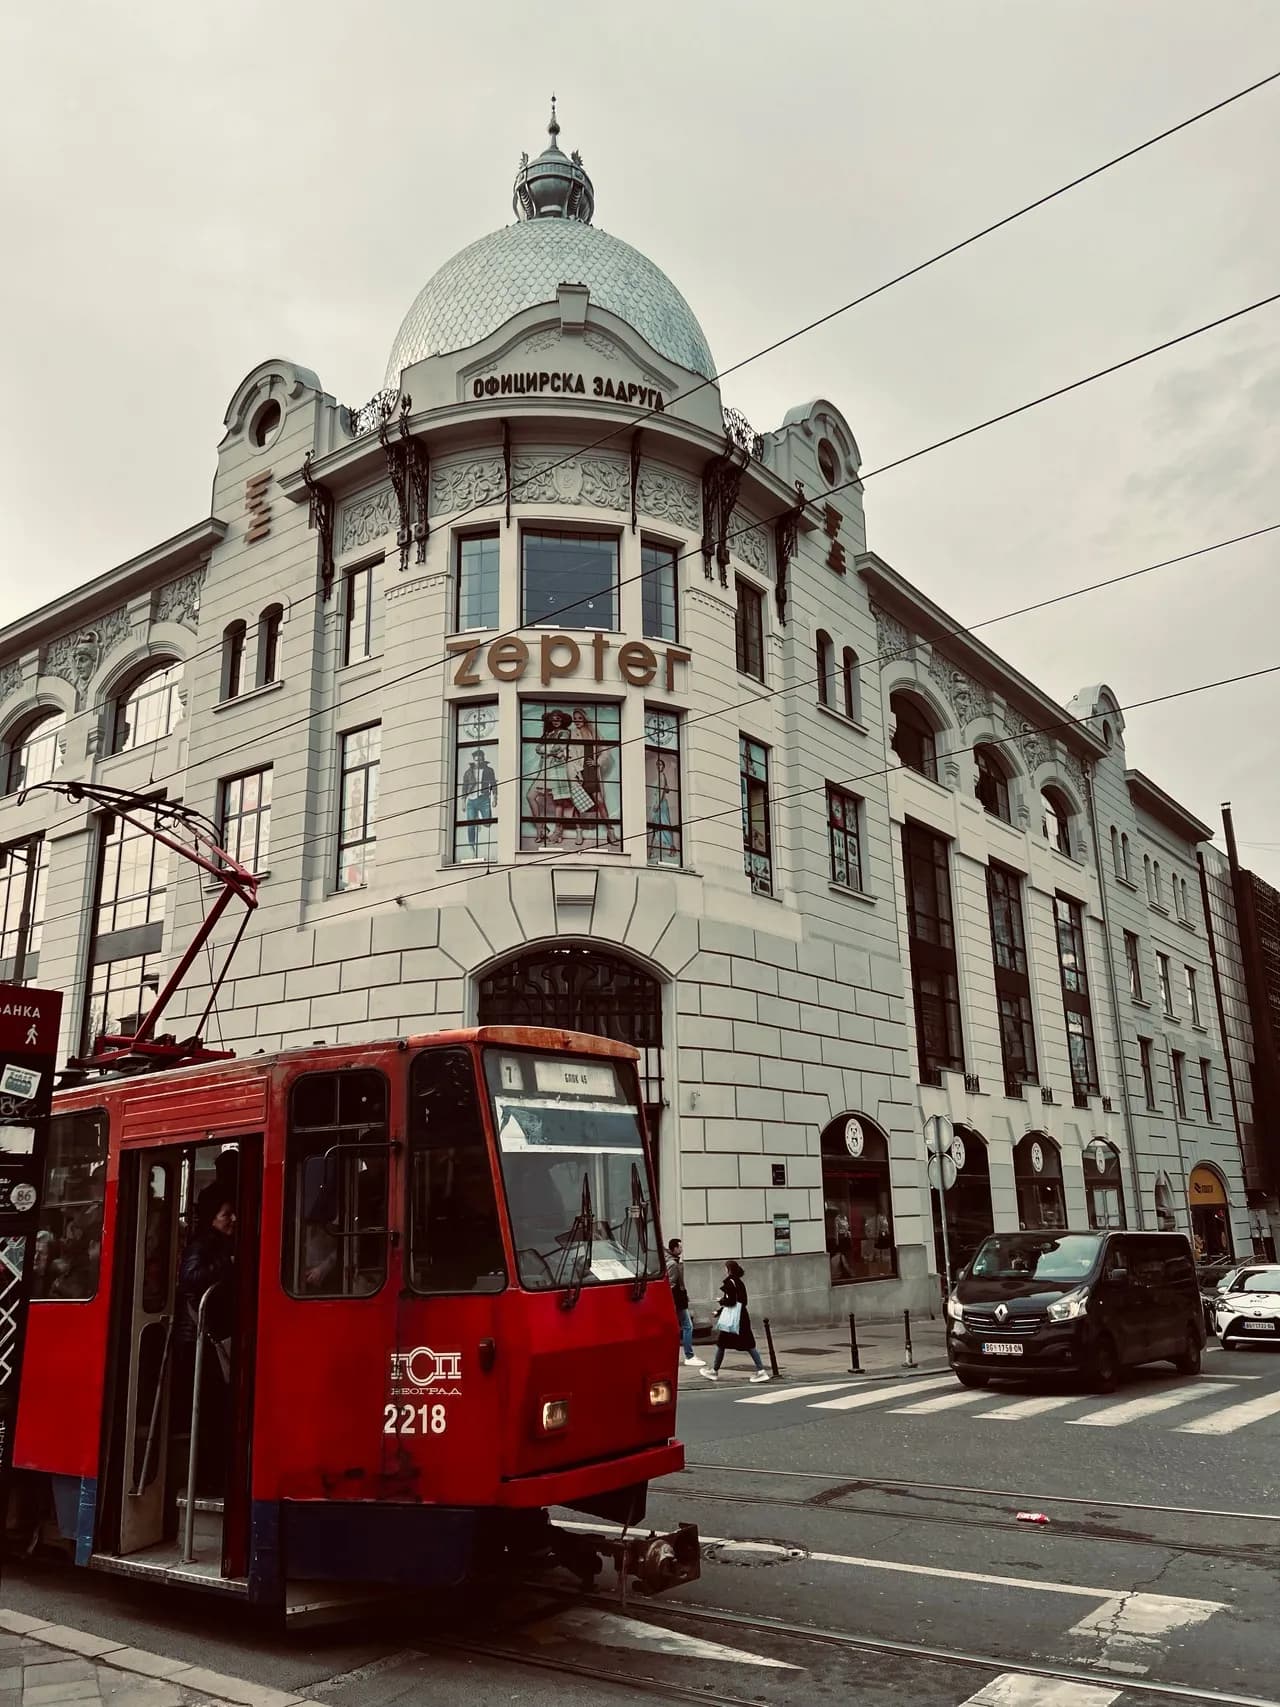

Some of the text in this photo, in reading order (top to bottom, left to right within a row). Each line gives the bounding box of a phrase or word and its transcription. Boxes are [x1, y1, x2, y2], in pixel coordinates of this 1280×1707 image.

[473, 372, 665, 412] ОФИЦИРСКА ЗАДРУГА
[446, 633, 692, 692] zepter
[0, 1003, 41, 1018] АНКА
[505, 1066, 513, 1084] 7
[17, 1190, 32, 1202] 86
[390, 1346, 462, 1387] ГСП
[384, 1403, 447, 1434] 2218
